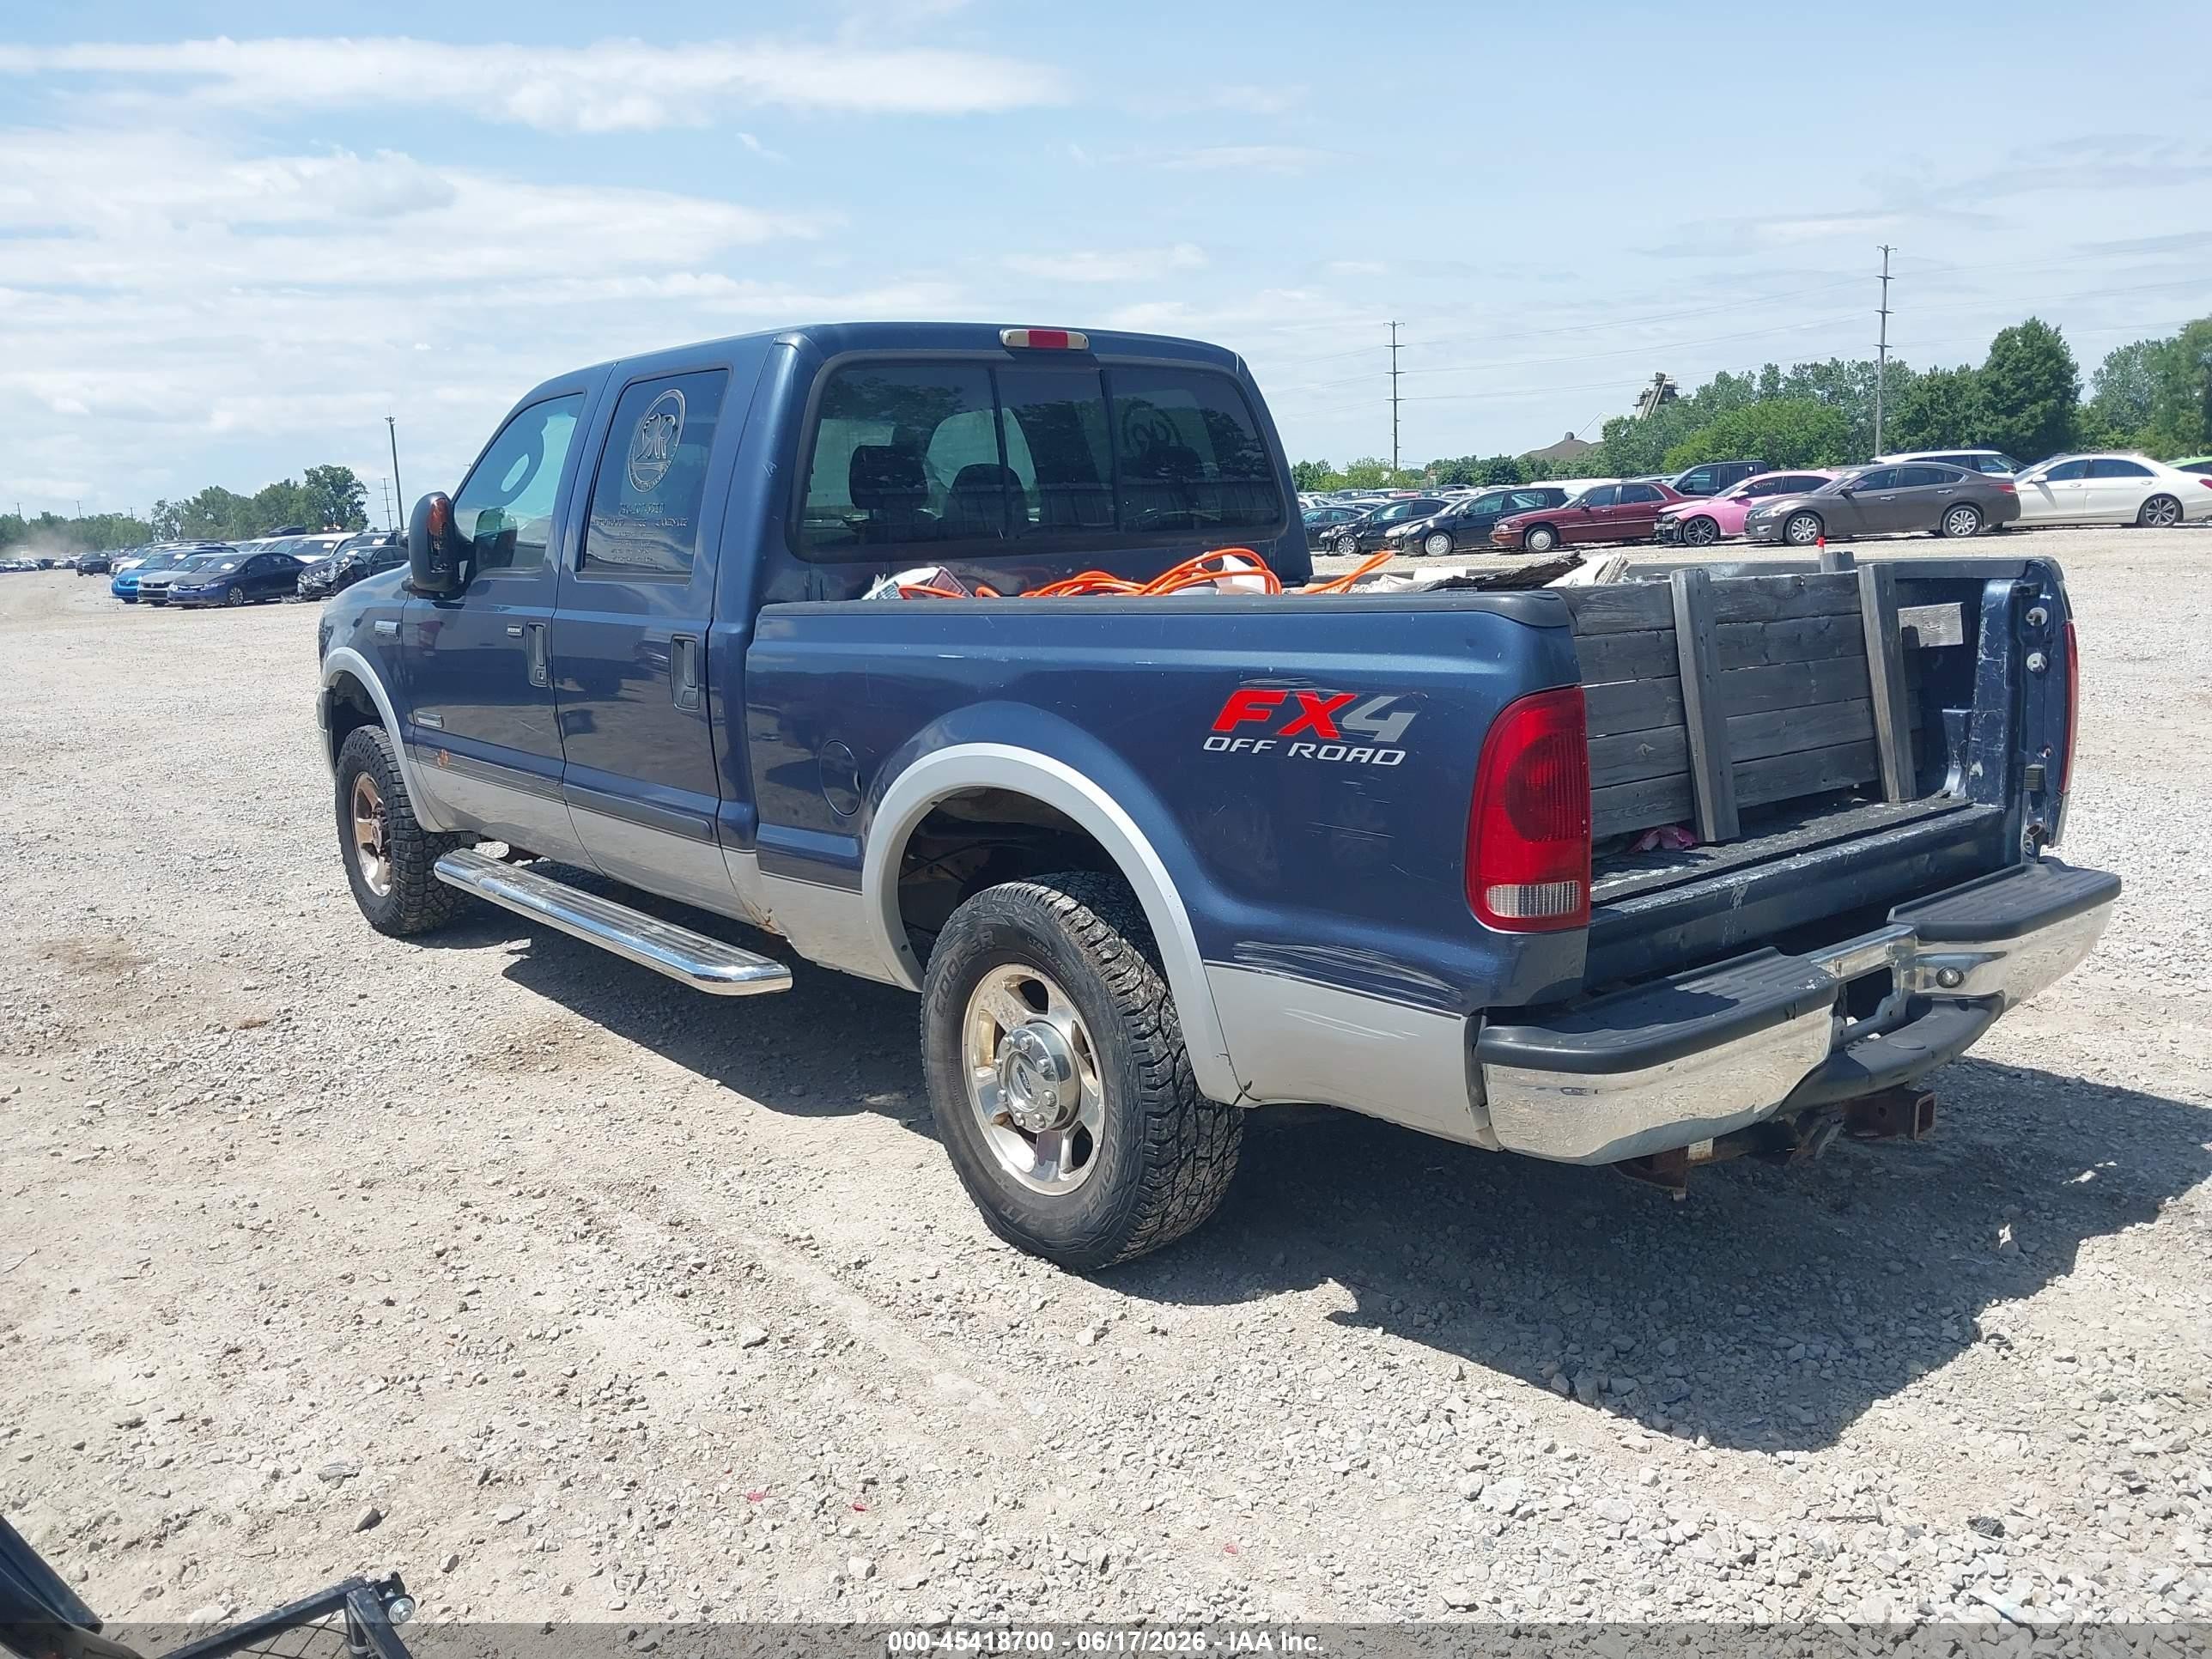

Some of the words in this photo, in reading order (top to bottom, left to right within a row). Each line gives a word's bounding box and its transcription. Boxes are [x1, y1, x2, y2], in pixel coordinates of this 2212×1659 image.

[1212, 688, 1418, 743] FX4
[1202, 736, 1277, 755] OFF
[1287, 741, 1407, 767] ROAD
[933, 928, 997, 1019] COOPER
